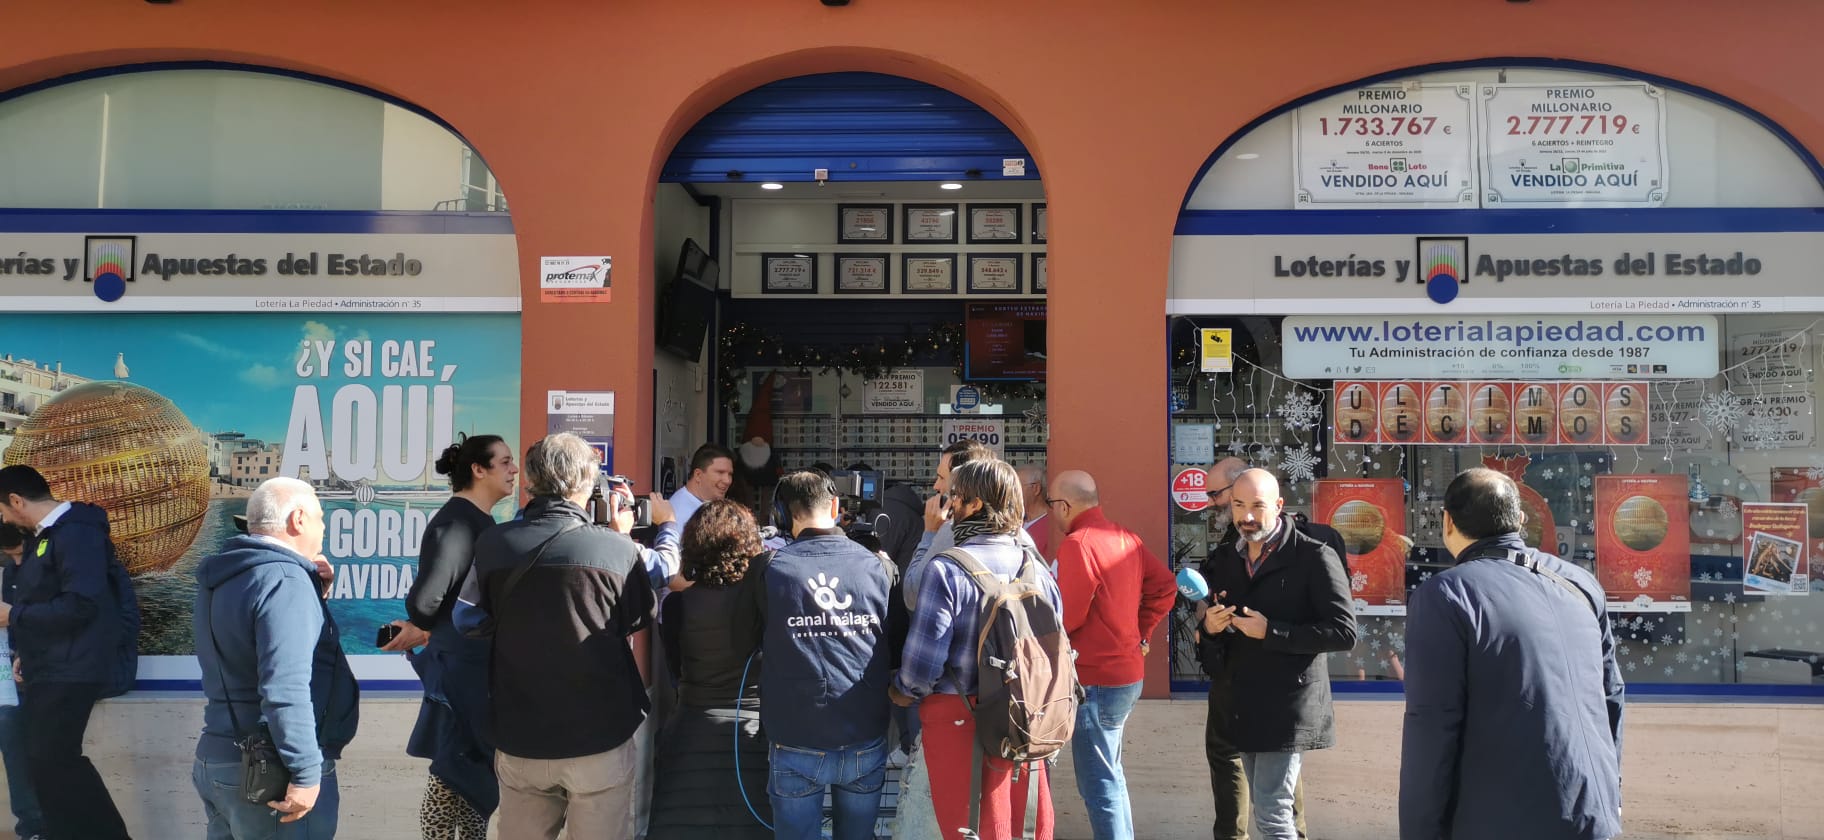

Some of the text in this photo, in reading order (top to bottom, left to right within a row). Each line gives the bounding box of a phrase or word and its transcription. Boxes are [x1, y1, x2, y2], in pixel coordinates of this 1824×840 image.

[1358, 90, 1406, 100] PREMIO
[1546, 88, 1595, 99] PREMIO
[1343, 104, 1423, 114] MILLONARIO
[1531, 102, 1612, 113] MILLONARIO
[1319, 117, 1452, 136] 1.733.767 €
[1506, 114, 1640, 136] 2.777.719 €
[1537, 139, 1570, 147] ACIERTOS
[1576, 139, 1614, 147] REINTEGRO
[1550, 162, 1625, 171] La Primitiva
[1321, 171, 1448, 188] VENDIDO AQUÍ
[1510, 170, 1638, 188] VENDIDO AQUÍ
[0, 252, 423, 281] rías y Apuestas del Estado
[1274, 251, 1762, 283] Loterías y Apuestas del Estado
[290, 300, 300, 308] La
[303, 299, 333, 308] Piedad
[340, 299, 400, 309] Administración
[413, 300, 422, 308] 35
[1626, 301, 1636, 310] La
[1638, 300, 1669, 310] Piedad
[1677, 299, 1739, 309] Administración
[1751, 300, 1761, 309] 35
[1294, 320, 1705, 347] www.loterialapiedad.com
[296, 339, 436, 378] ¿Y SI CAE
[1349, 346, 1650, 358] Tu Administración de confianza desde 1987
[1770, 395, 1807, 404] PREMIO
[278, 364, 458, 482] AQUÍ
[1180, 473, 1204, 487] +18
[330, 508, 442, 558] GORD
[329, 564, 419, 600] AVIDA
[787, 611, 878, 627] canal málaga
